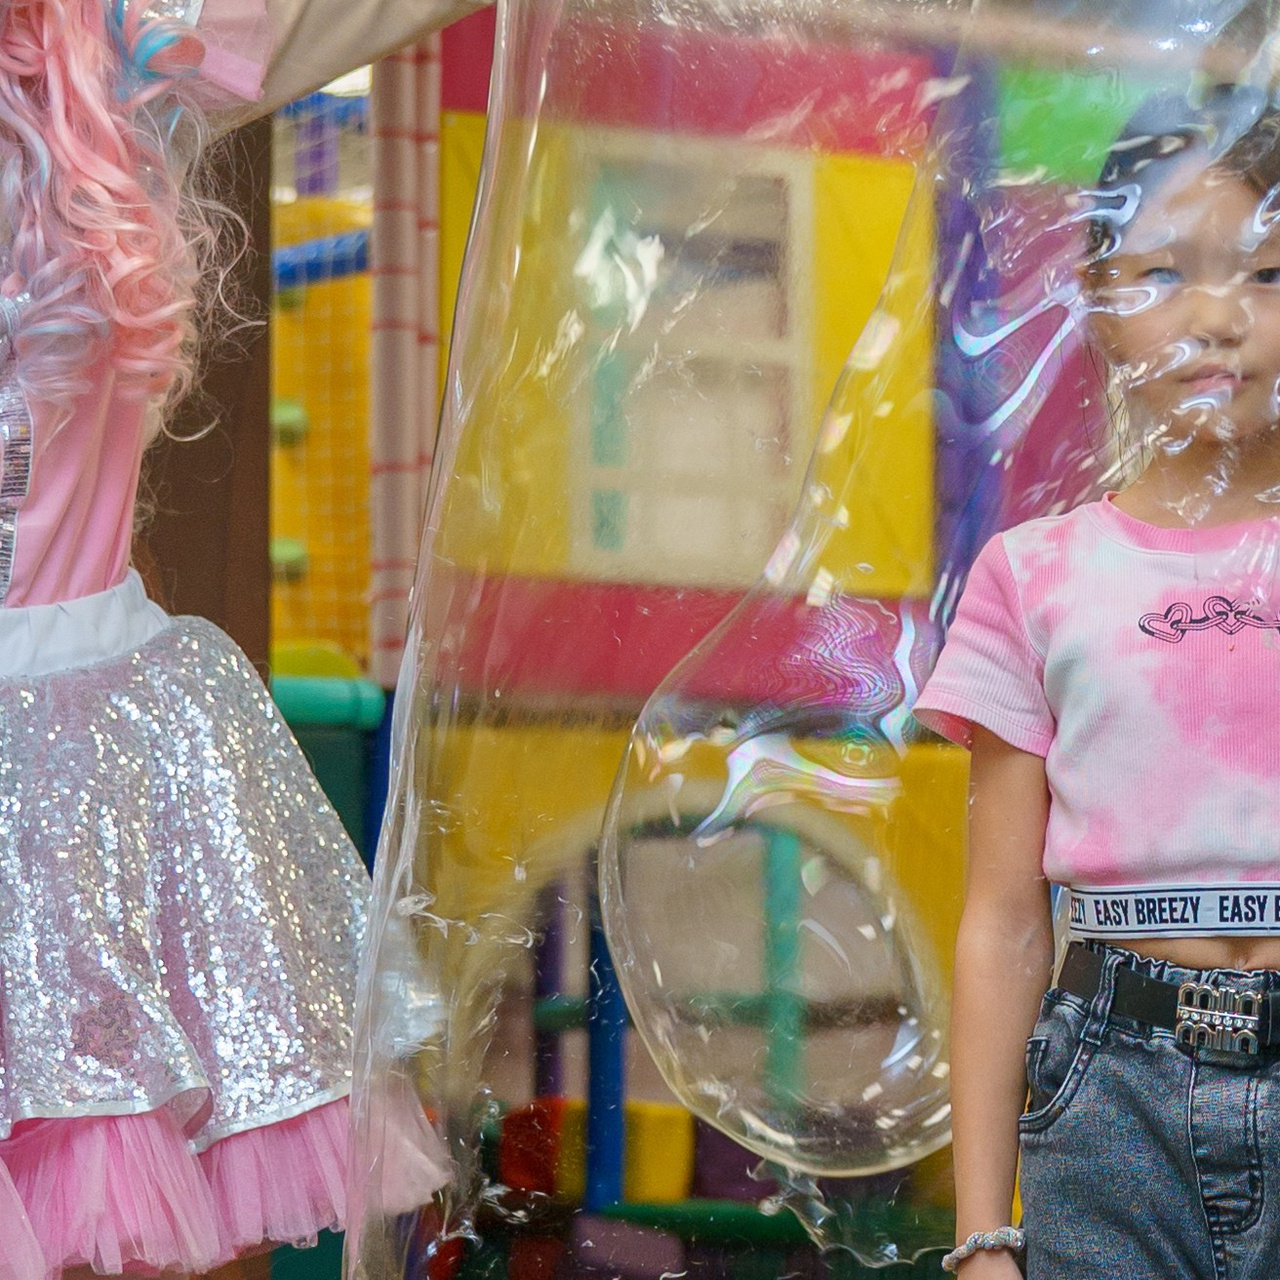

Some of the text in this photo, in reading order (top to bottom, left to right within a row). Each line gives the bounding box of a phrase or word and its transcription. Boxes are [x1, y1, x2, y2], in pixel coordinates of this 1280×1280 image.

[1093, 899, 1129, 926] EASY
[1134, 896, 1200, 925] BREEZY
[1219, 895, 1268, 922] EASY
